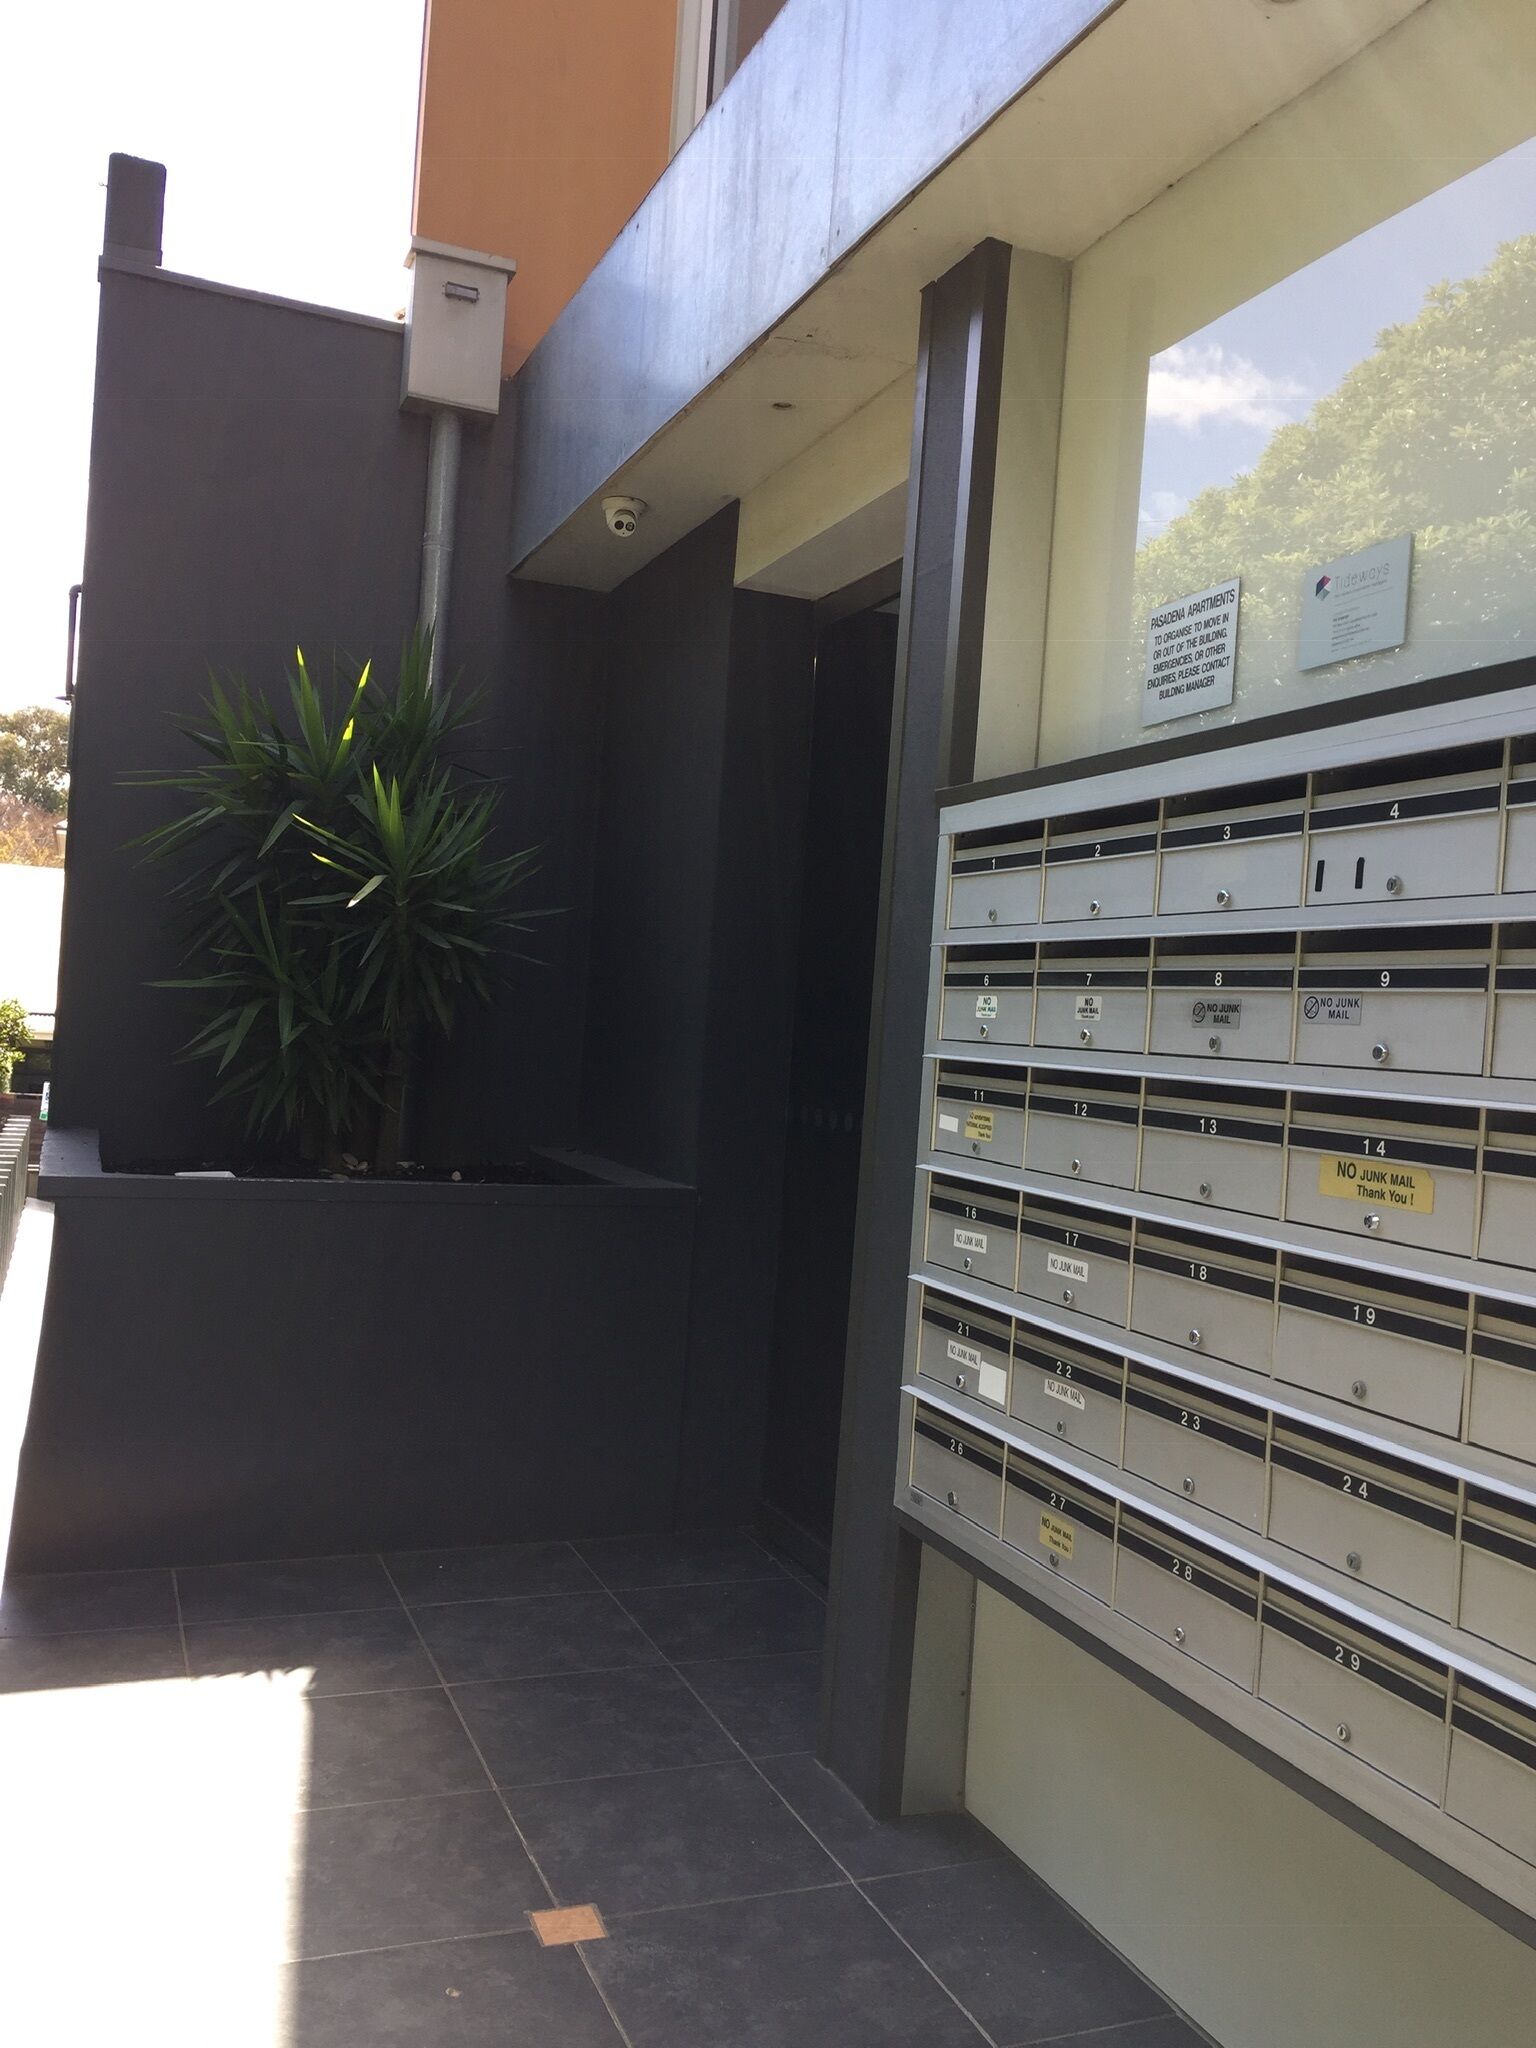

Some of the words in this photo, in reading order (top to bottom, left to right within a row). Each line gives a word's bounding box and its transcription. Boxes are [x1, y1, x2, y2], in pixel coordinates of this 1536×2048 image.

[1150, 607, 1185, 630] PASADENA
[1187, 588, 1236, 618] APARTMENTS
[1154, 635, 1162, 647] TO
[1163, 624, 1192, 643] ORGANISE
[1194, 621, 1203, 633] TO
[1203, 614, 1222, 630] MOVE
[1222, 612, 1230, 624] IN
[1153, 649, 1162, 661] OR
[1163, 644, 1175, 658] OUT
[1176, 641, 1185, 654] OF
[1186, 636, 1198, 650] THE
[1194, 649, 1204, 661] OR
[1205, 642, 1226, 659] OTHER
[1177, 664, 1201, 680] PLEASE
[1201, 655, 1231, 674] CONTACT
[1159, 684, 1185, 700] BUILDING
[1186, 675, 1215, 693] MANAGER
[1390, 803, 1399, 819] 4
[1223, 825, 1231, 840] 3
[1094, 844, 1101, 857] 2
[991, 857, 996, 870] 1
[983, 974, 990, 987] 6
[1086, 972, 1092, 986] 7
[1214, 971, 1223, 986] 8
[1380, 971, 1391, 987] 9
[983, 996, 992, 1006] NO
[1084, 997, 1094, 1007] NO
[1206, 1003, 1217, 1013] NO
[1219, 1003, 1240, 1013] JUNK
[1320, 997, 1332, 1008] NO
[1335, 998, 1360, 1008] JUNK
[1213, 1014, 1231, 1024] MAIL
[1328, 1010, 1350, 1020] MAIL
[973, 1090, 985, 1102] 11
[1073, 1102, 1088, 1117] 12
[1199, 1118, 1218, 1135] 13
[1363, 1138, 1386, 1157] 14
[1337, 1160, 1357, 1179] NO
[1360, 1169, 1387, 1185] JUNK
[1390, 1173, 1416, 1189] MAIL
[1357, 1184, 1386, 1201] Thank
[1389, 1189, 1407, 1205] You
[965, 1206, 977, 1220] 16
[956, 1233, 962, 1244] NO
[963, 1234, 974, 1247] JUNK
[974, 1236, 984, 1250] MAIL
[1065, 1231, 1079, 1247] 17
[1050, 1257, 1059, 1270] NO
[1059, 1260, 1073, 1273] JUNK
[1073, 1263, 1085, 1278] MAIL
[1190, 1263, 1208, 1281] 18
[1353, 1304, 1376, 1325] 19
[957, 1321, 970, 1337] 21
[957, 1347, 968, 1361] JUNK
[968, 1351, 978, 1366] MAIL
[1056, 1360, 1072, 1379] 22
[1047, 1379, 1055, 1393] NO
[1056, 1383, 1070, 1399] JUNK
[1070, 1388, 1082, 1405] MAIL
[1181, 1411, 1201, 1430] 23
[950, 1439, 964, 1456] 26
[1343, 1474, 1368, 1499] 24
[1050, 1492, 1066, 1511] 27
[1041, 1515, 1051, 1529] NO
[1172, 1558, 1193, 1581] 28
[1334, 1645, 1361, 1672] 29
